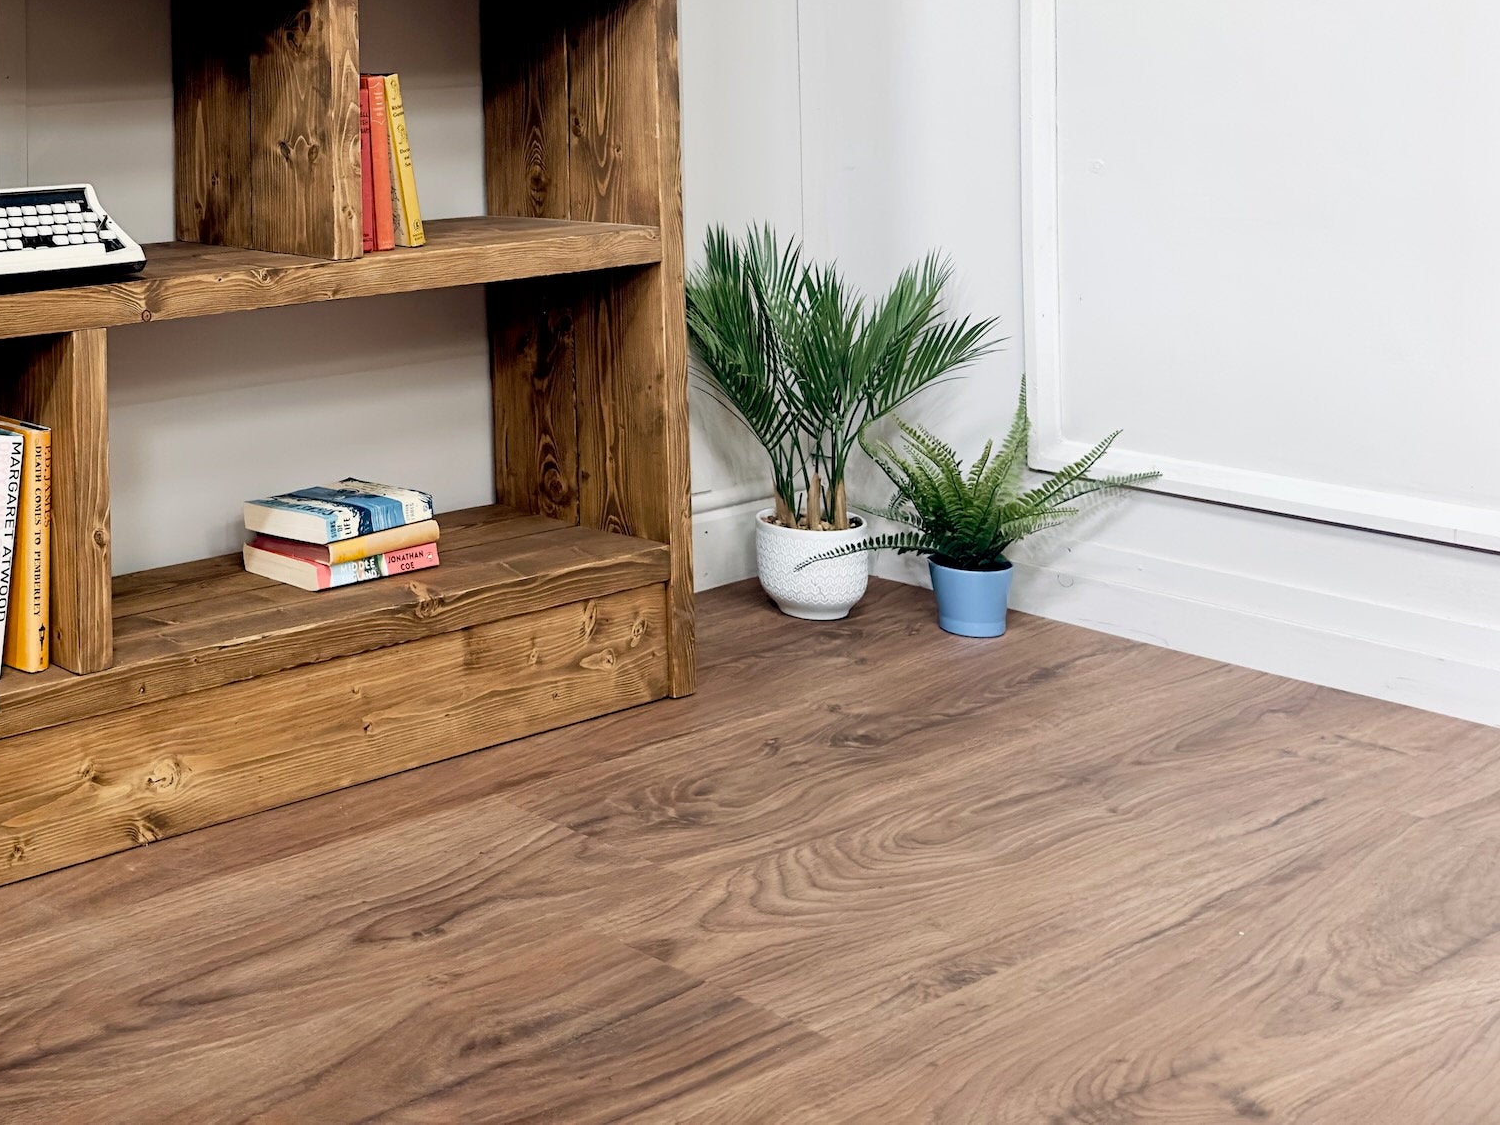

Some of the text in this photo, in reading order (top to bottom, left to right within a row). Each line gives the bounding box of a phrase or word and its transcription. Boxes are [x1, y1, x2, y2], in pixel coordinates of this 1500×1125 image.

[4, 441, 22, 540] MARGARET
[34, 487, 42, 526] COMES
[43, 475, 51, 528] JAMES
[343, 517, 352, 535] LIFE
[34, 530, 41, 545] TO
[340, 558, 376, 572] MIDDLE
[388, 550, 424, 564] JONATHAN
[400, 562, 415, 571] COE
